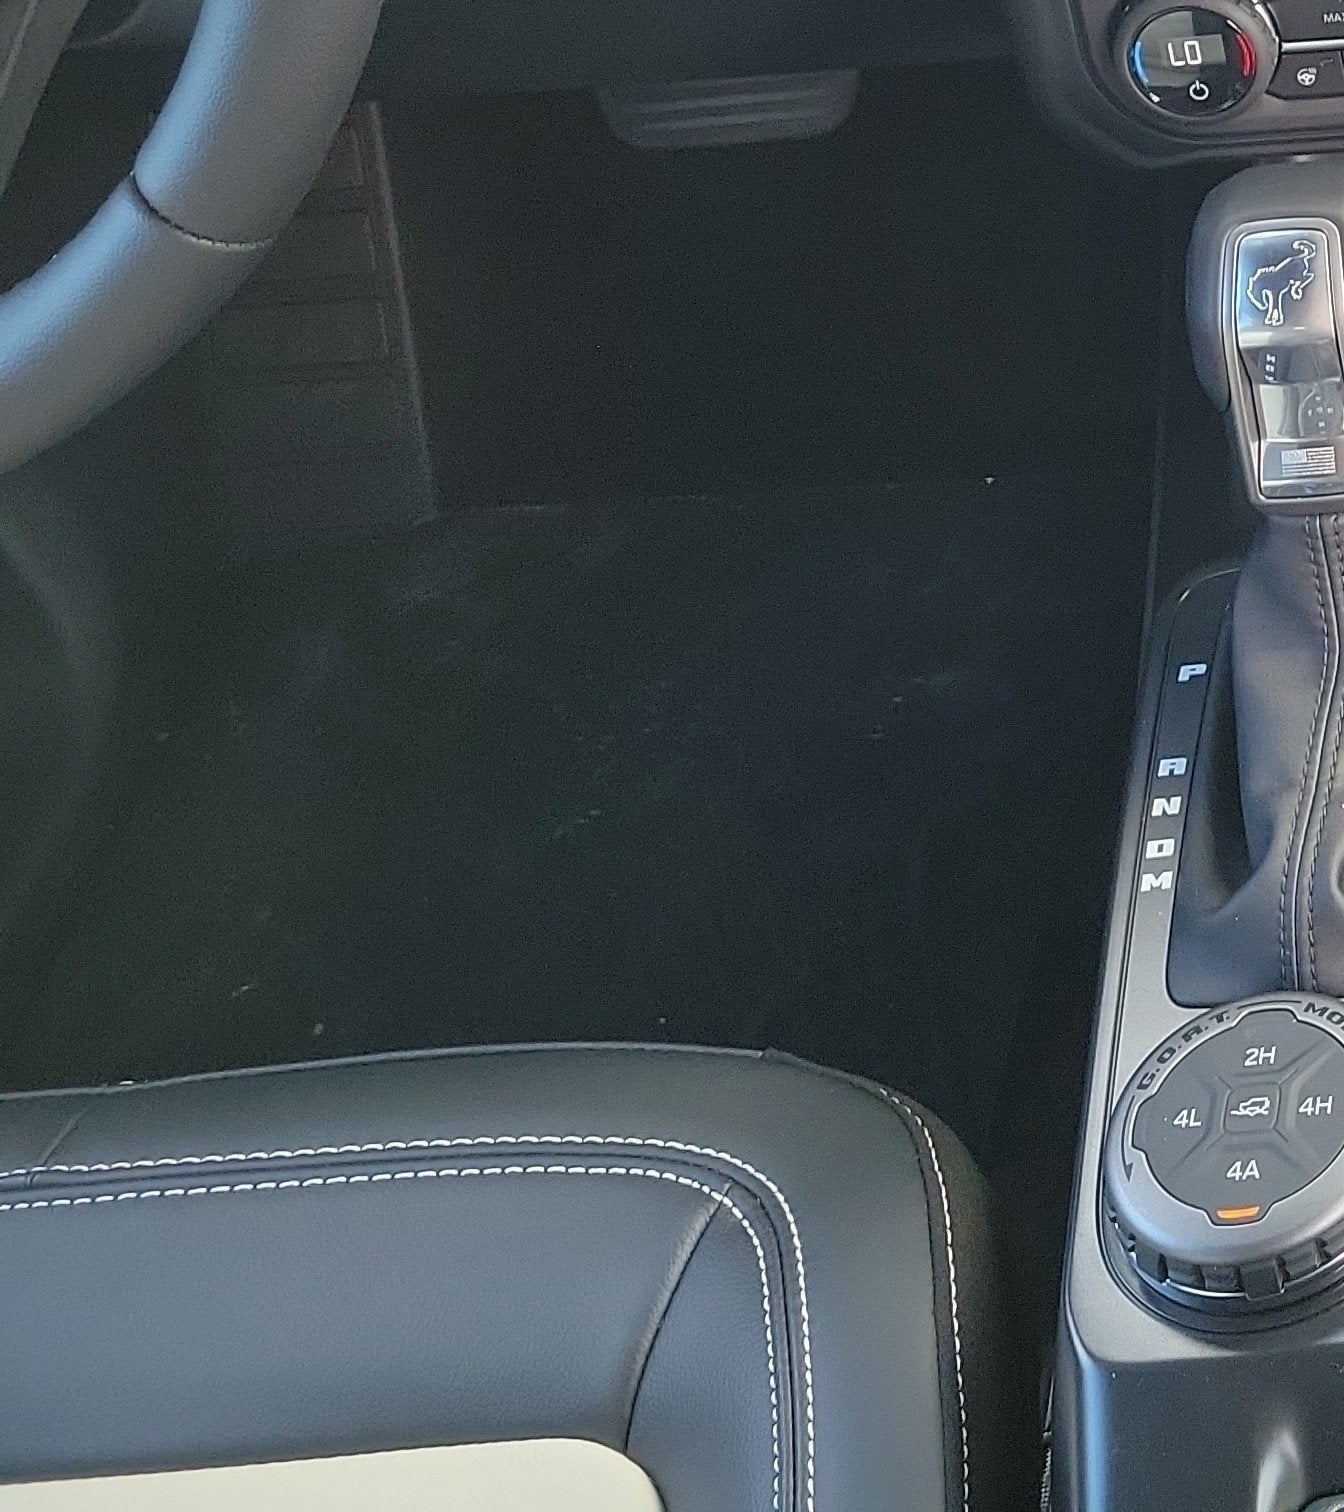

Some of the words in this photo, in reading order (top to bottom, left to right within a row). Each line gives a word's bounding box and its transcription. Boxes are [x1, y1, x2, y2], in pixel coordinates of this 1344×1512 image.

[1167, 40, 1202, 67] LO
[1178, 662, 1208, 682] P
[1150, 795, 1183, 817] N
[1145, 838, 1175, 860] D
[1140, 870, 1174, 892] M
[1244, 1045, 1277, 1068] 2H
[1298, 1095, 1333, 1116] 4H
[1173, 1106, 1202, 1128] 4L
[1226, 1159, 1262, 1181] 4A
